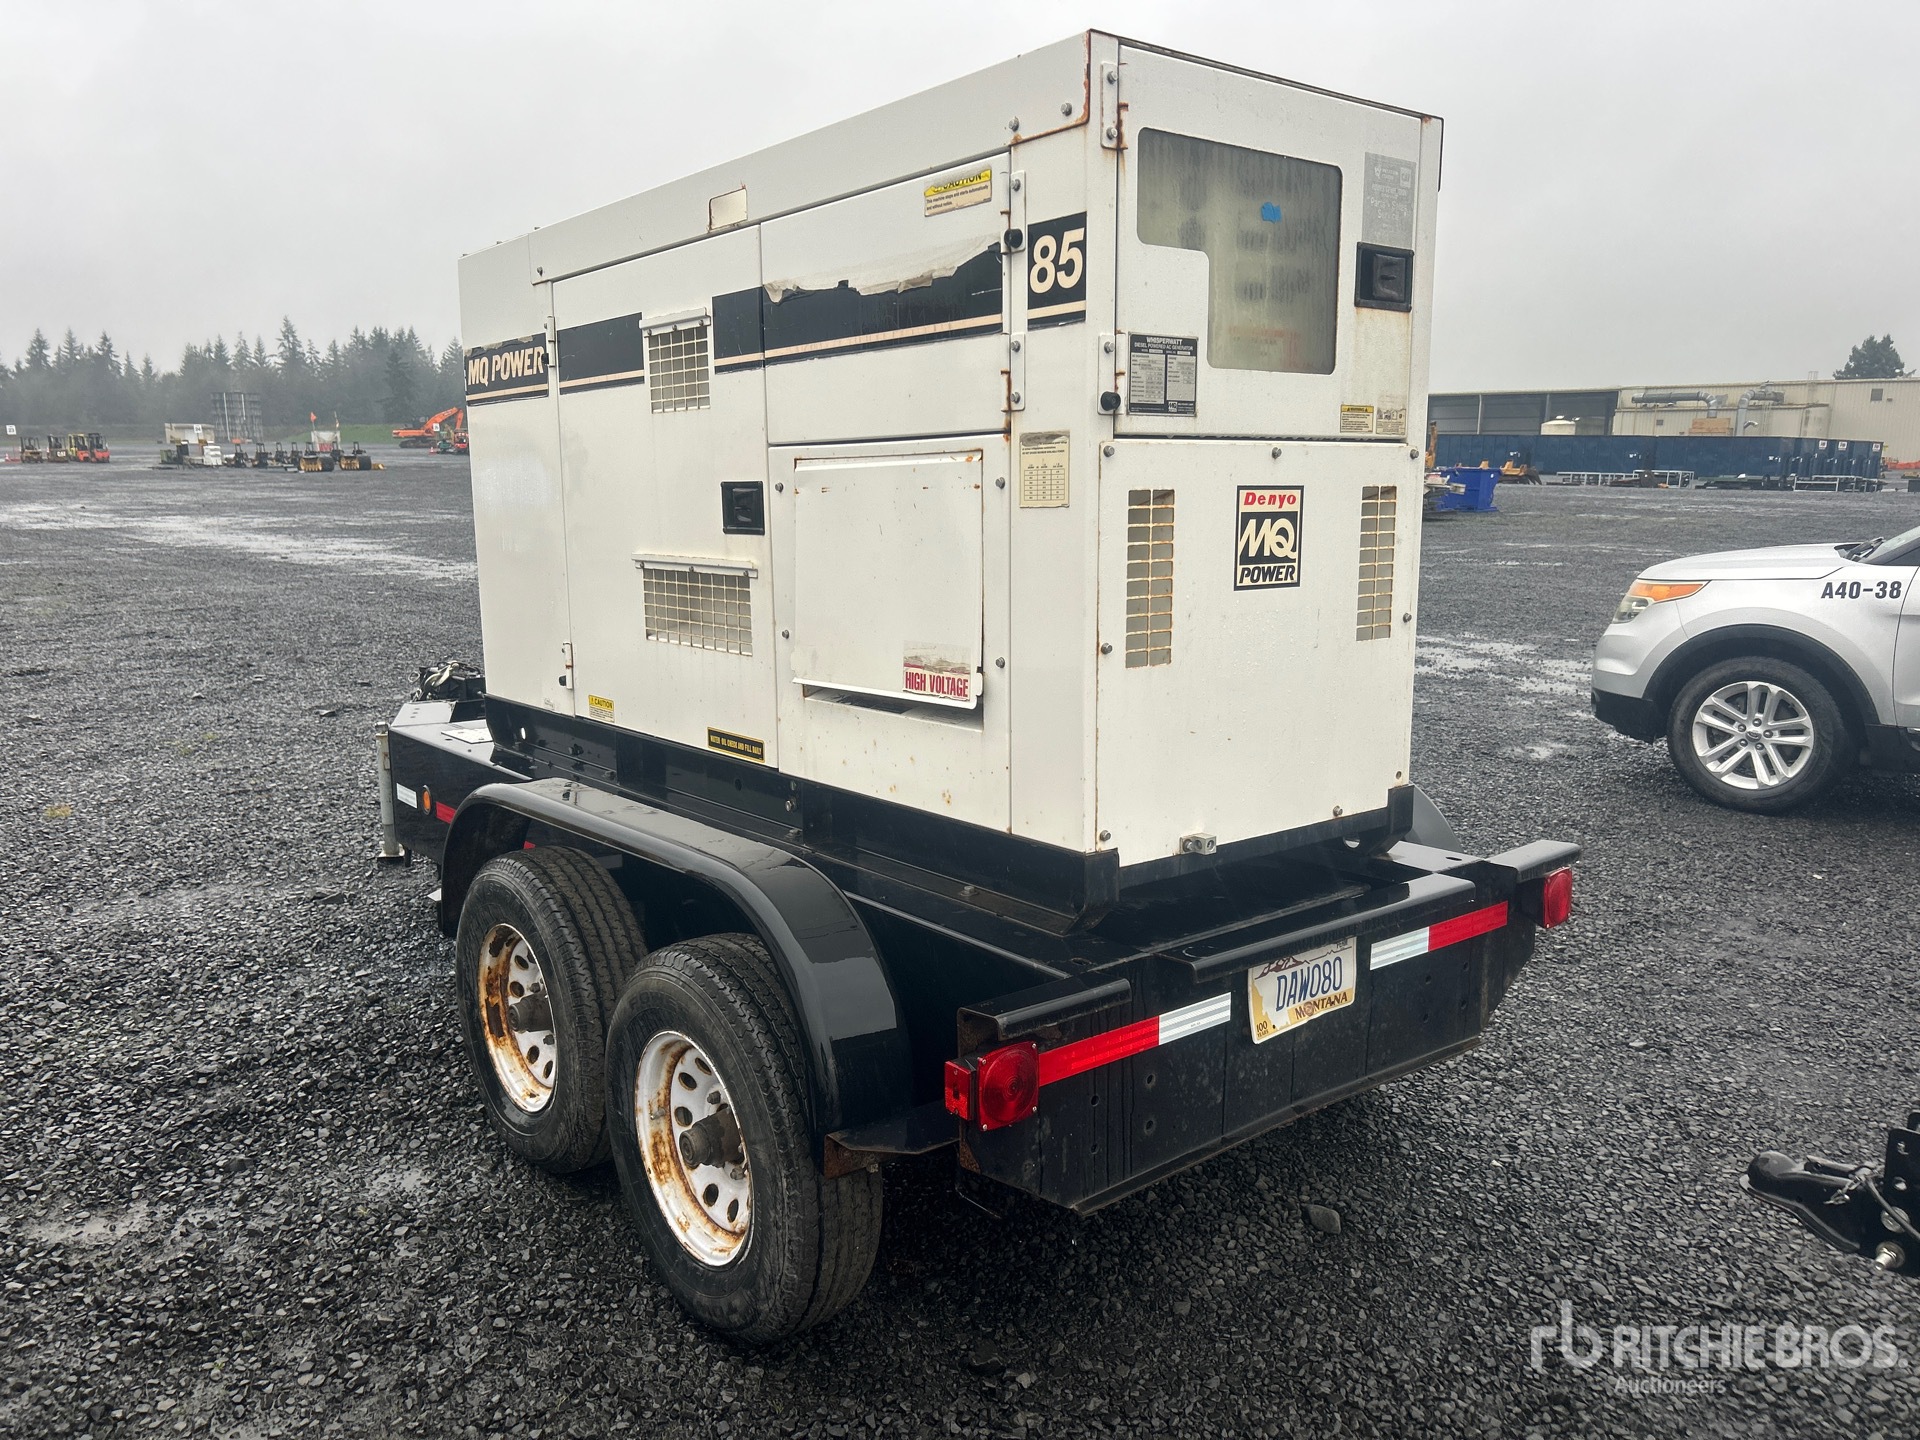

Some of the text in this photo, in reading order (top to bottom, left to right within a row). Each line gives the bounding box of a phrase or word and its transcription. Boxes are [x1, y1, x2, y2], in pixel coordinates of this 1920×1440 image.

[1030, 227, 1085, 294] 85
[468, 346, 545, 387] MQ POWER
[1243, 491, 1297, 509] Denyo
[1239, 518, 1297, 559] MQ
[1239, 565, 1295, 584] POWER
[1821, 581, 1902, 599] A40-38
[905, 671, 968, 697] HIGH VOLTAGE
[594, 698, 613, 709] CAUTION
[1275, 956, 1343, 1012] DAW080
[1294, 991, 1348, 1020] MONTANA
[1257, 1020, 1268, 1033] 100
